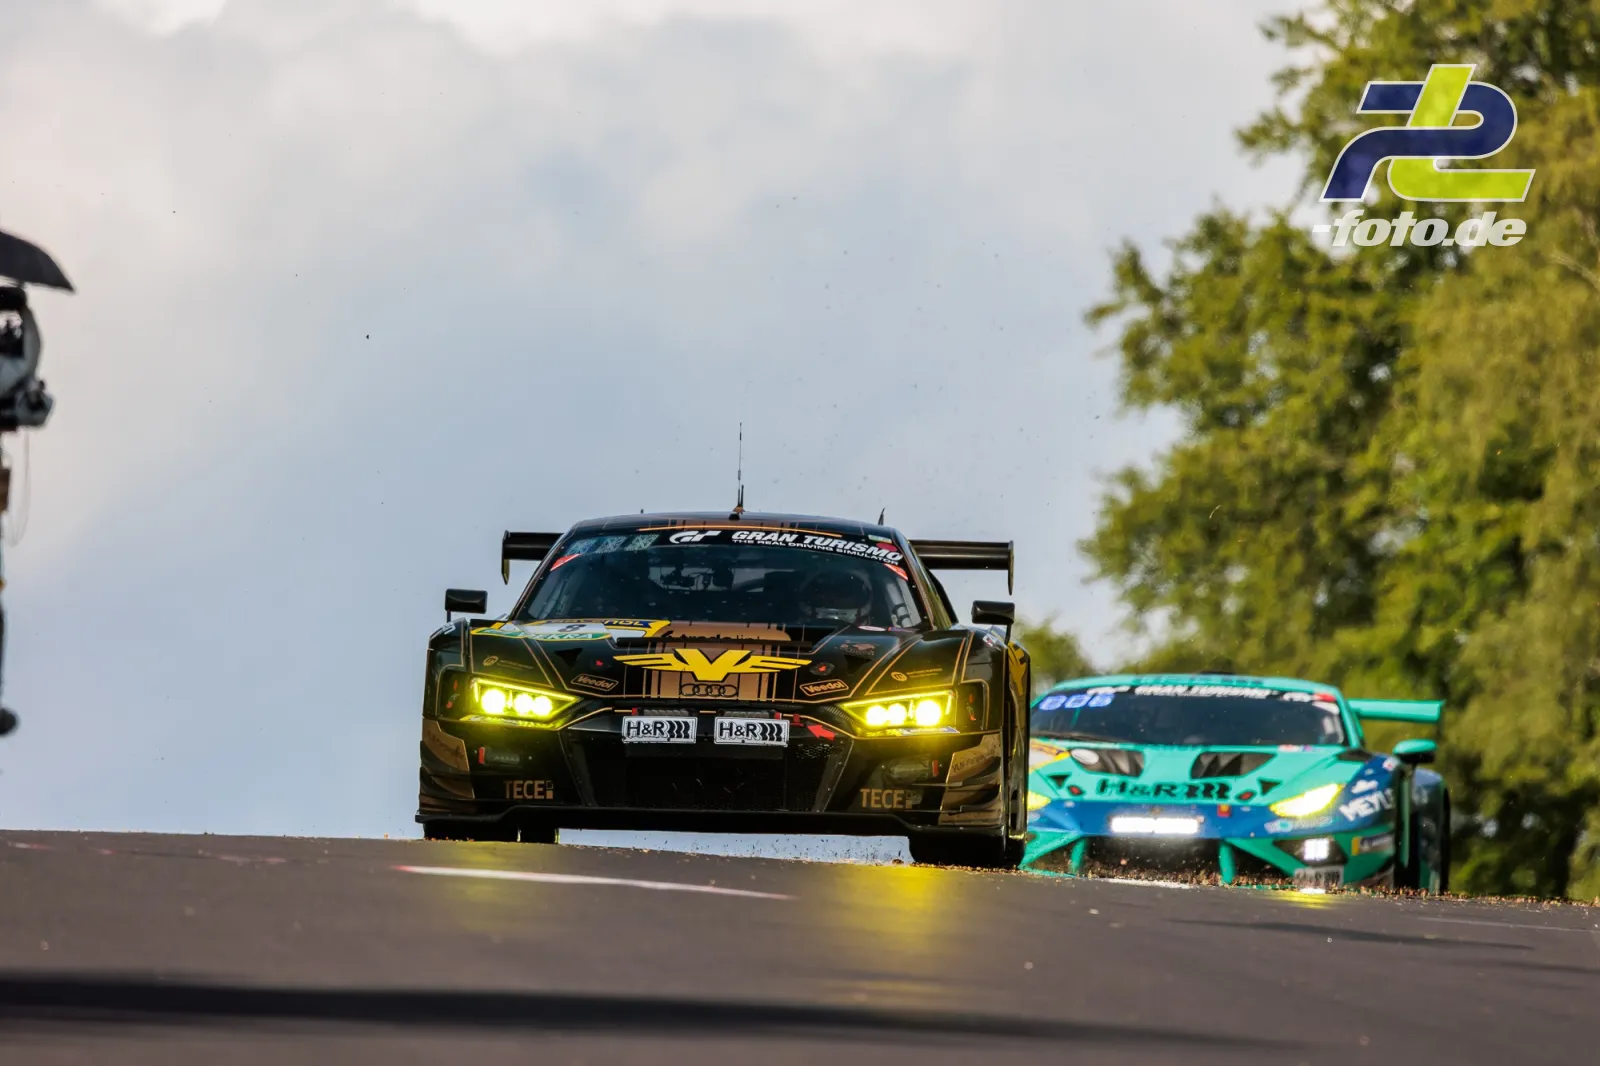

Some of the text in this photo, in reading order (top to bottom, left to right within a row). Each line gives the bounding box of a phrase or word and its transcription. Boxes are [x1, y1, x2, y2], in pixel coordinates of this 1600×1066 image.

[731, 530, 797, 543] GRAN
[803, 534, 904, 562] TURISMO
[788, 542, 835, 552] DRIVING
[836, 548, 900, 566] SIMULATOR
[577, 675, 615, 689] Veedol
[804, 681, 844, 693] Veedol
[627, 720, 668, 738] H&R
[719, 722, 760, 738] H&R
[503, 779, 545, 800] TECE
[1096, 778, 1178, 798] H&R
[859, 788, 905, 809] TECE
